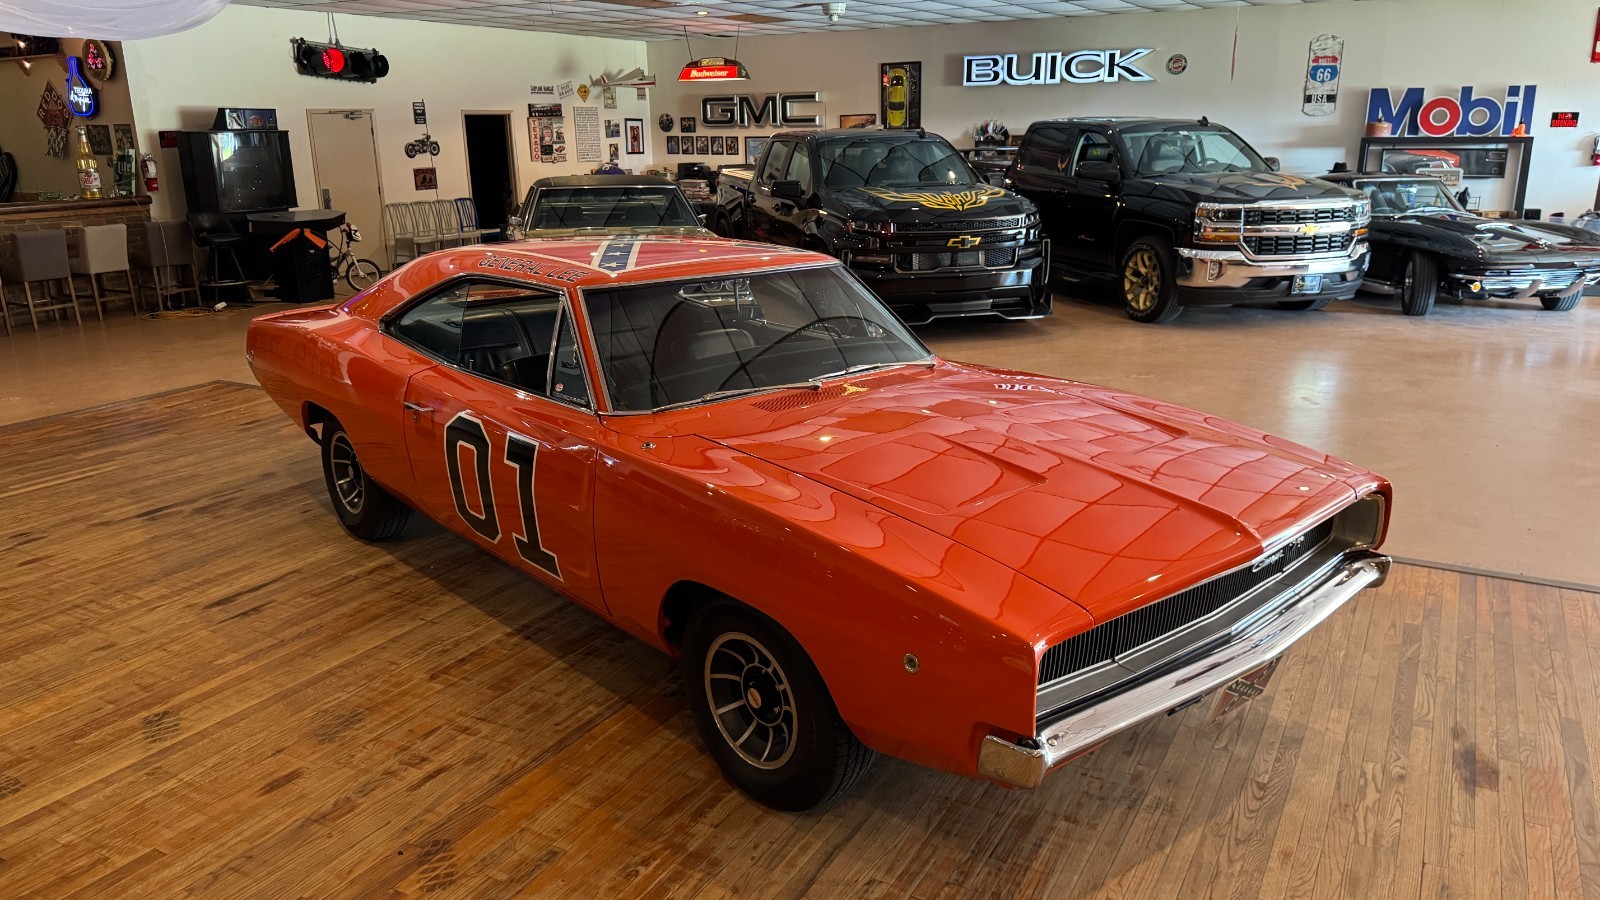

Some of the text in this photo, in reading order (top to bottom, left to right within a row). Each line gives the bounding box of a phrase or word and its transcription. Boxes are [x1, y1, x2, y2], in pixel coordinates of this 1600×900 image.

[690, 69, 729, 78] Budweiser
[963, 48, 1156, 87] BUICK
[1316, 68, 1332, 82] 66
[38, 91, 51, 119] RED
[51, 91, 69, 119] DOG
[700, 91, 820, 127] GMC
[1311, 94, 1327, 104] USA
[1366, 84, 1537, 137] Mobil
[1551, 119, 1577, 127] SMOKING
[1558, 112, 1573, 120] NO
[531, 119, 540, 160] TEXACO
[478, 254, 590, 283] GENERAL LEE
[443, 411, 565, 583] 01
